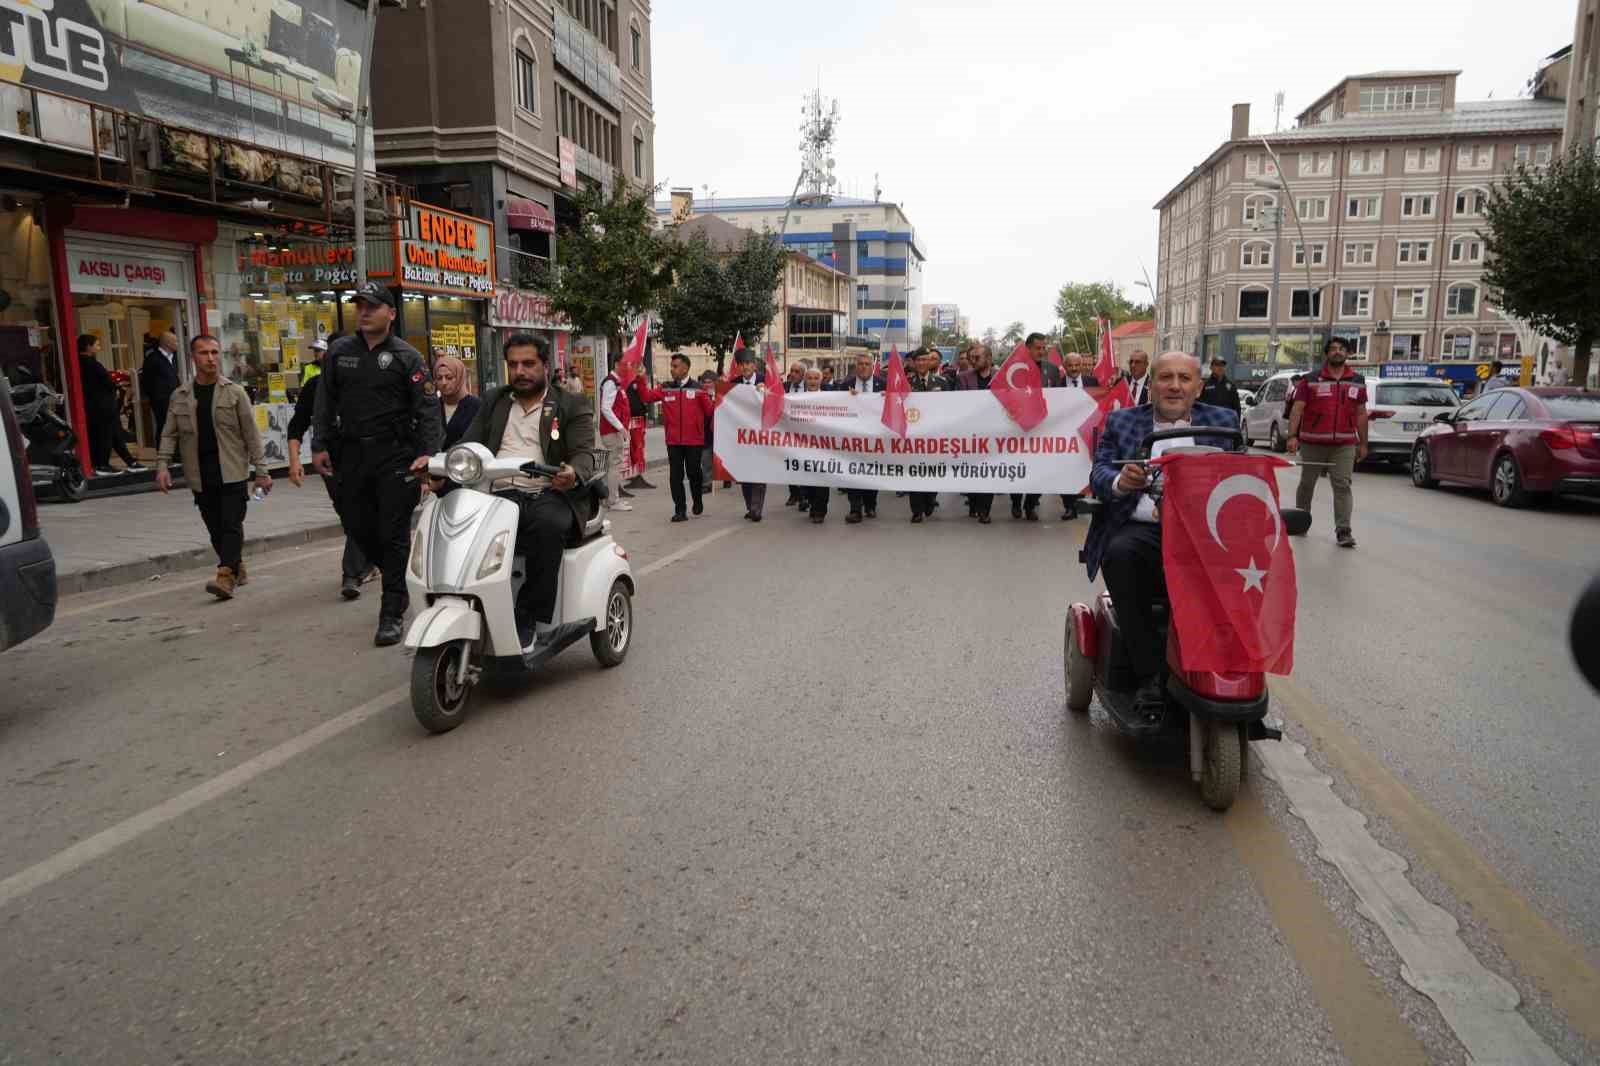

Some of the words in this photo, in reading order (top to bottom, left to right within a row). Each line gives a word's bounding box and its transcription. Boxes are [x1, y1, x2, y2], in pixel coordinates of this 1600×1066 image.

[419, 210, 477, 251] ENDER
[78, 260, 120, 278] AKSU
[123, 263, 166, 286] ÇARŞI
[404, 265, 439, 283] Baklava
[443, 271, 465, 287] Pasta
[736, 428, 885, 454] KAHRAMANLARLA
[890, 434, 990, 459] KARDEŞLİK
[995, 436, 1080, 454] YOLUNDA
[784, 457, 800, 471] 19
[803, 457, 844, 474] EYLÜL
[848, 460, 904, 477] GAZİLER
[908, 462, 947, 478] GÜNÜ
[951, 462, 1027, 482] YÜRÜYÜŞÜ
